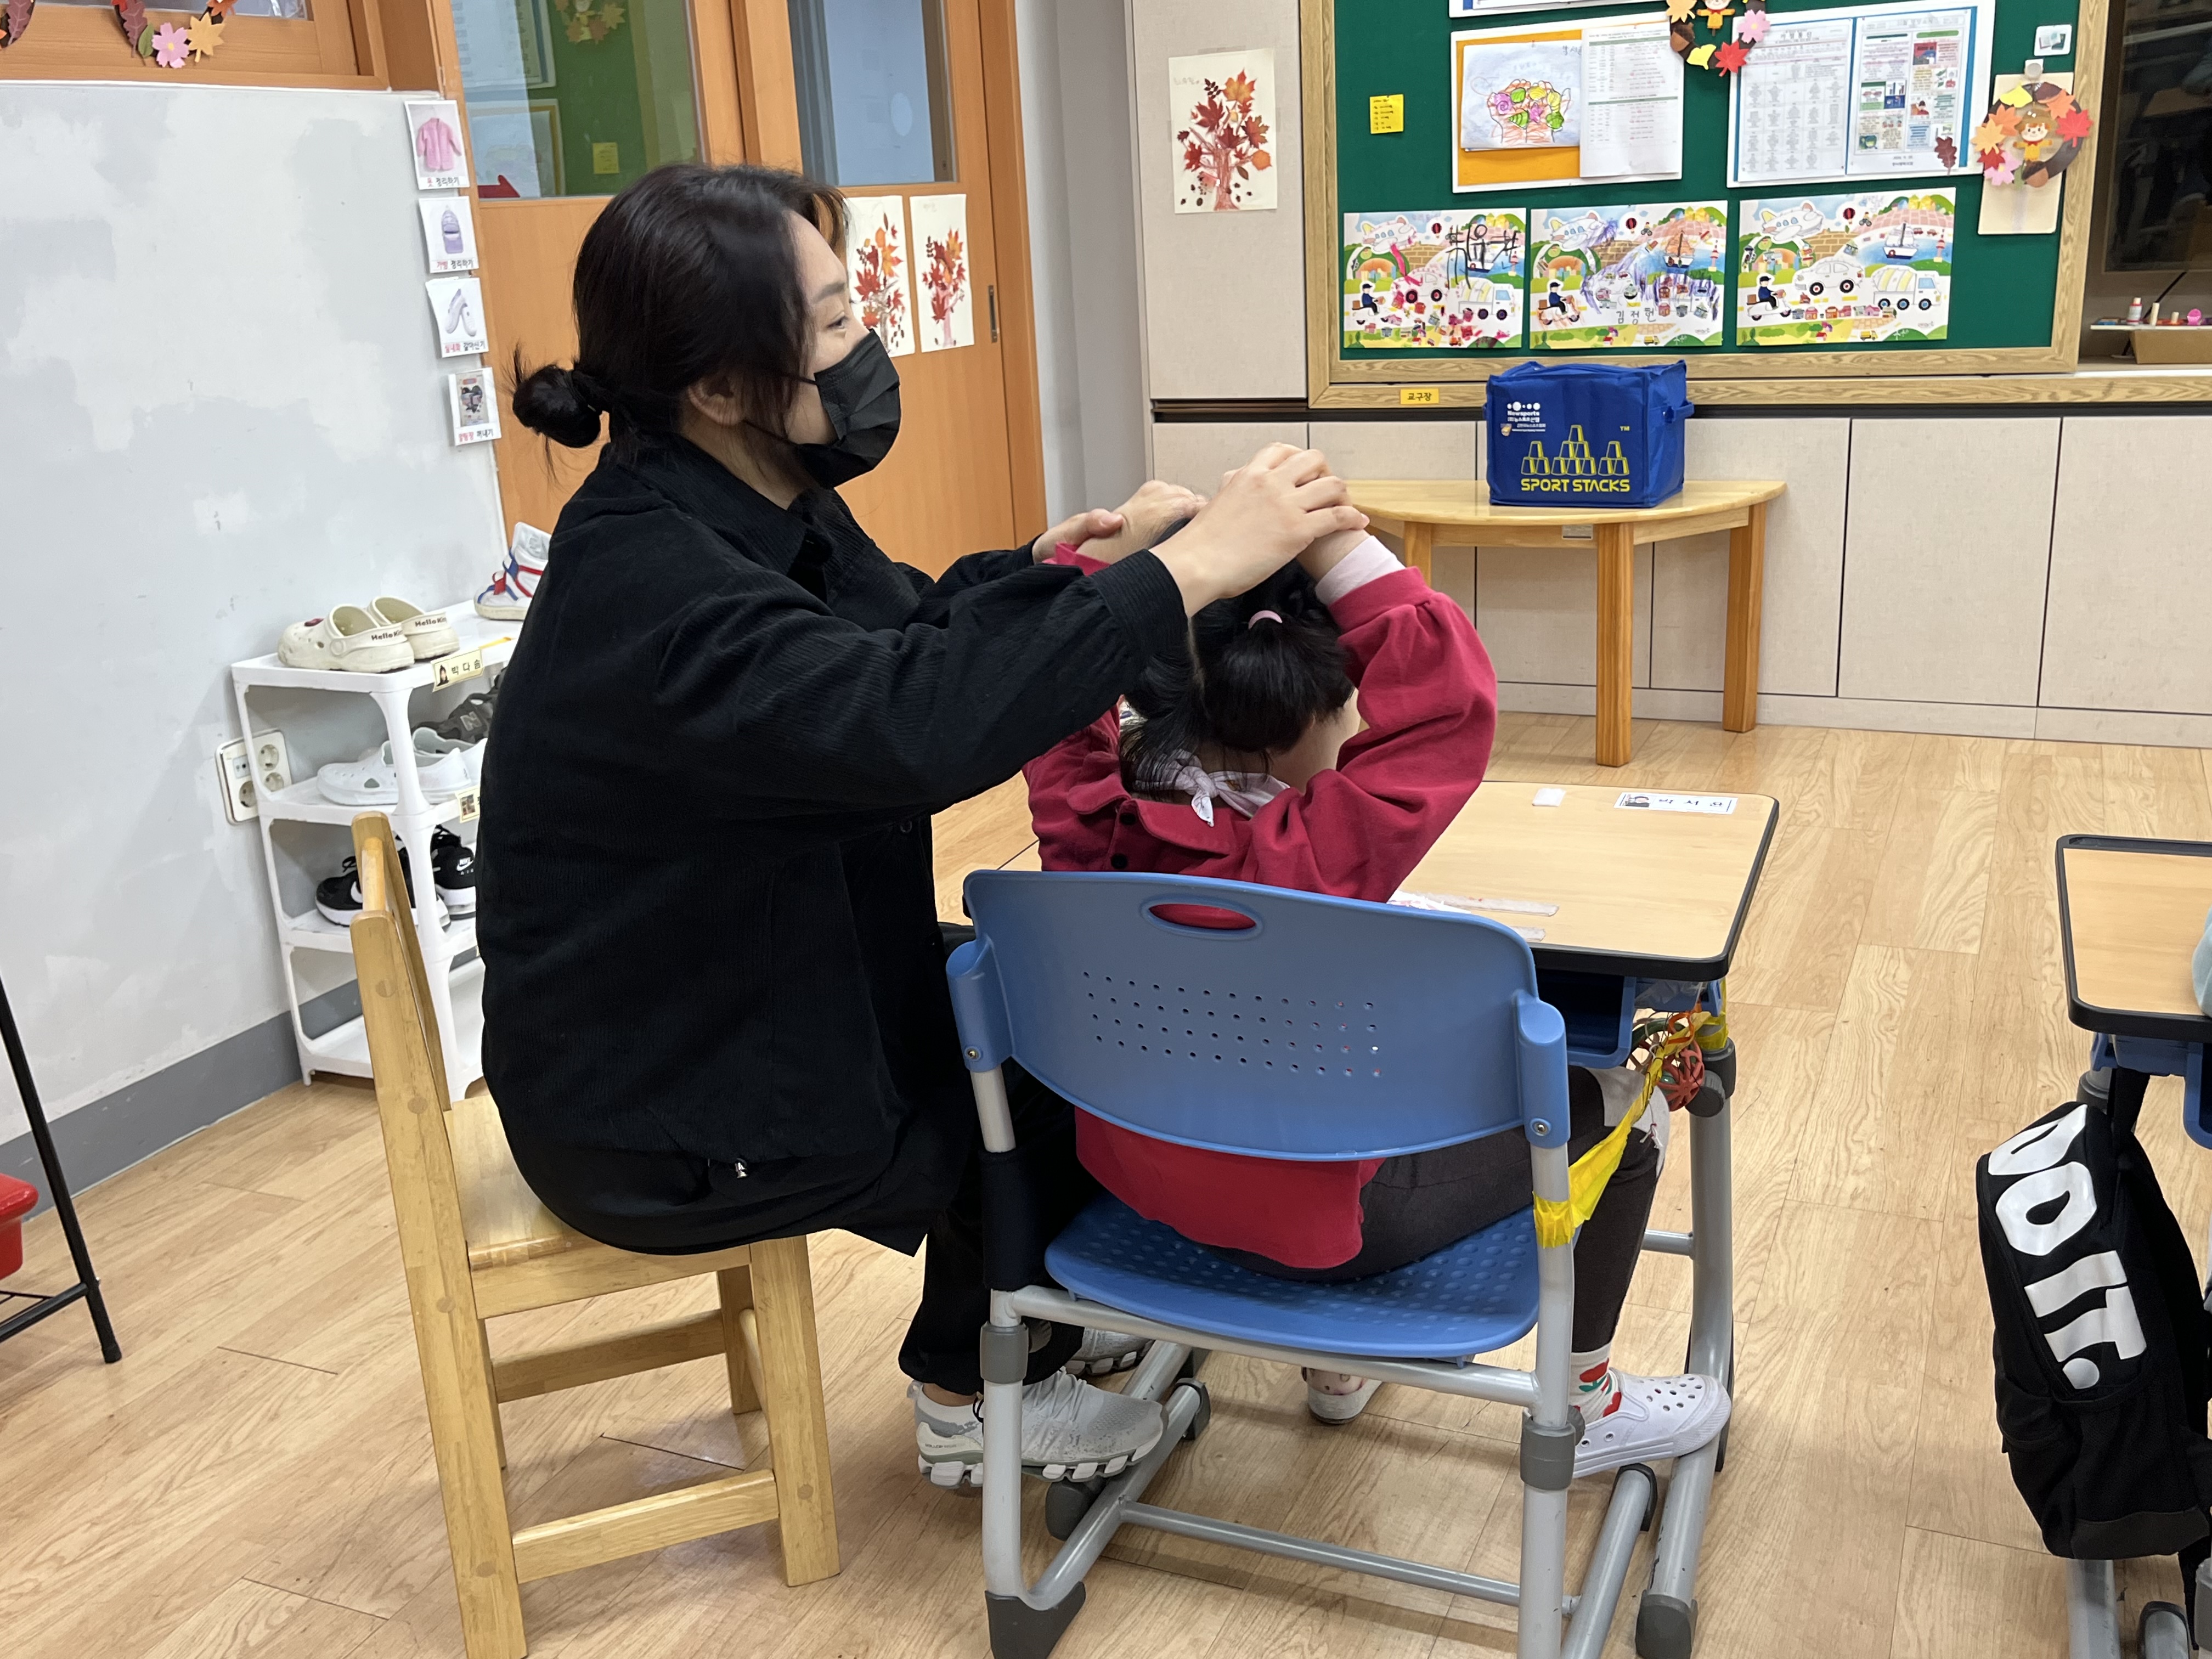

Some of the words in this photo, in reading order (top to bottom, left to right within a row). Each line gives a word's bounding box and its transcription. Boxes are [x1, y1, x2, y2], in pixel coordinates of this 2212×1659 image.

[436, 177, 460, 187] 정리하기
[437, 261, 448, 270] 가방
[451, 259, 473, 269] 정리하기
[1407, 392, 1432, 402] 교구장
[1521, 478, 1570, 492] SPORT
[1572, 479, 1630, 492] STACKS
